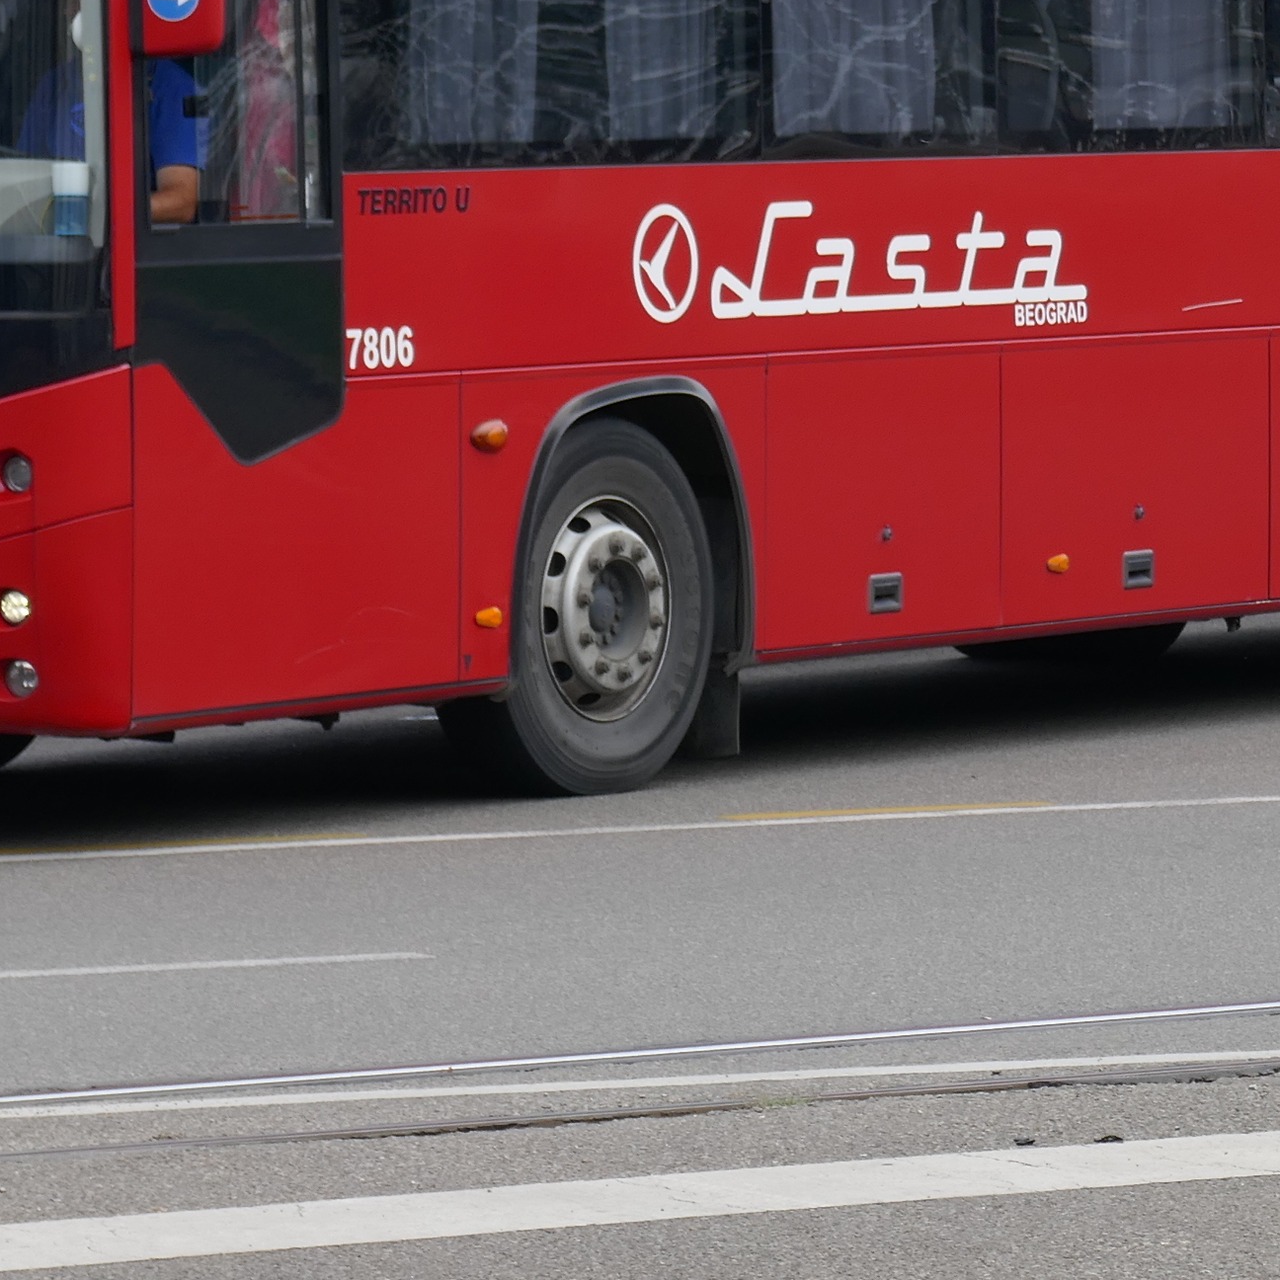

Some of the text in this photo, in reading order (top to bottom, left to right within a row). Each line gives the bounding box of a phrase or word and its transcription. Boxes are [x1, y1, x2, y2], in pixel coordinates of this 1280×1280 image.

[357, 186, 470, 215] TERRITO U
[711, 201, 1087, 319] Lasta
[1014, 301, 1087, 327] BEOGRAD
[346, 325, 414, 370] 7806
